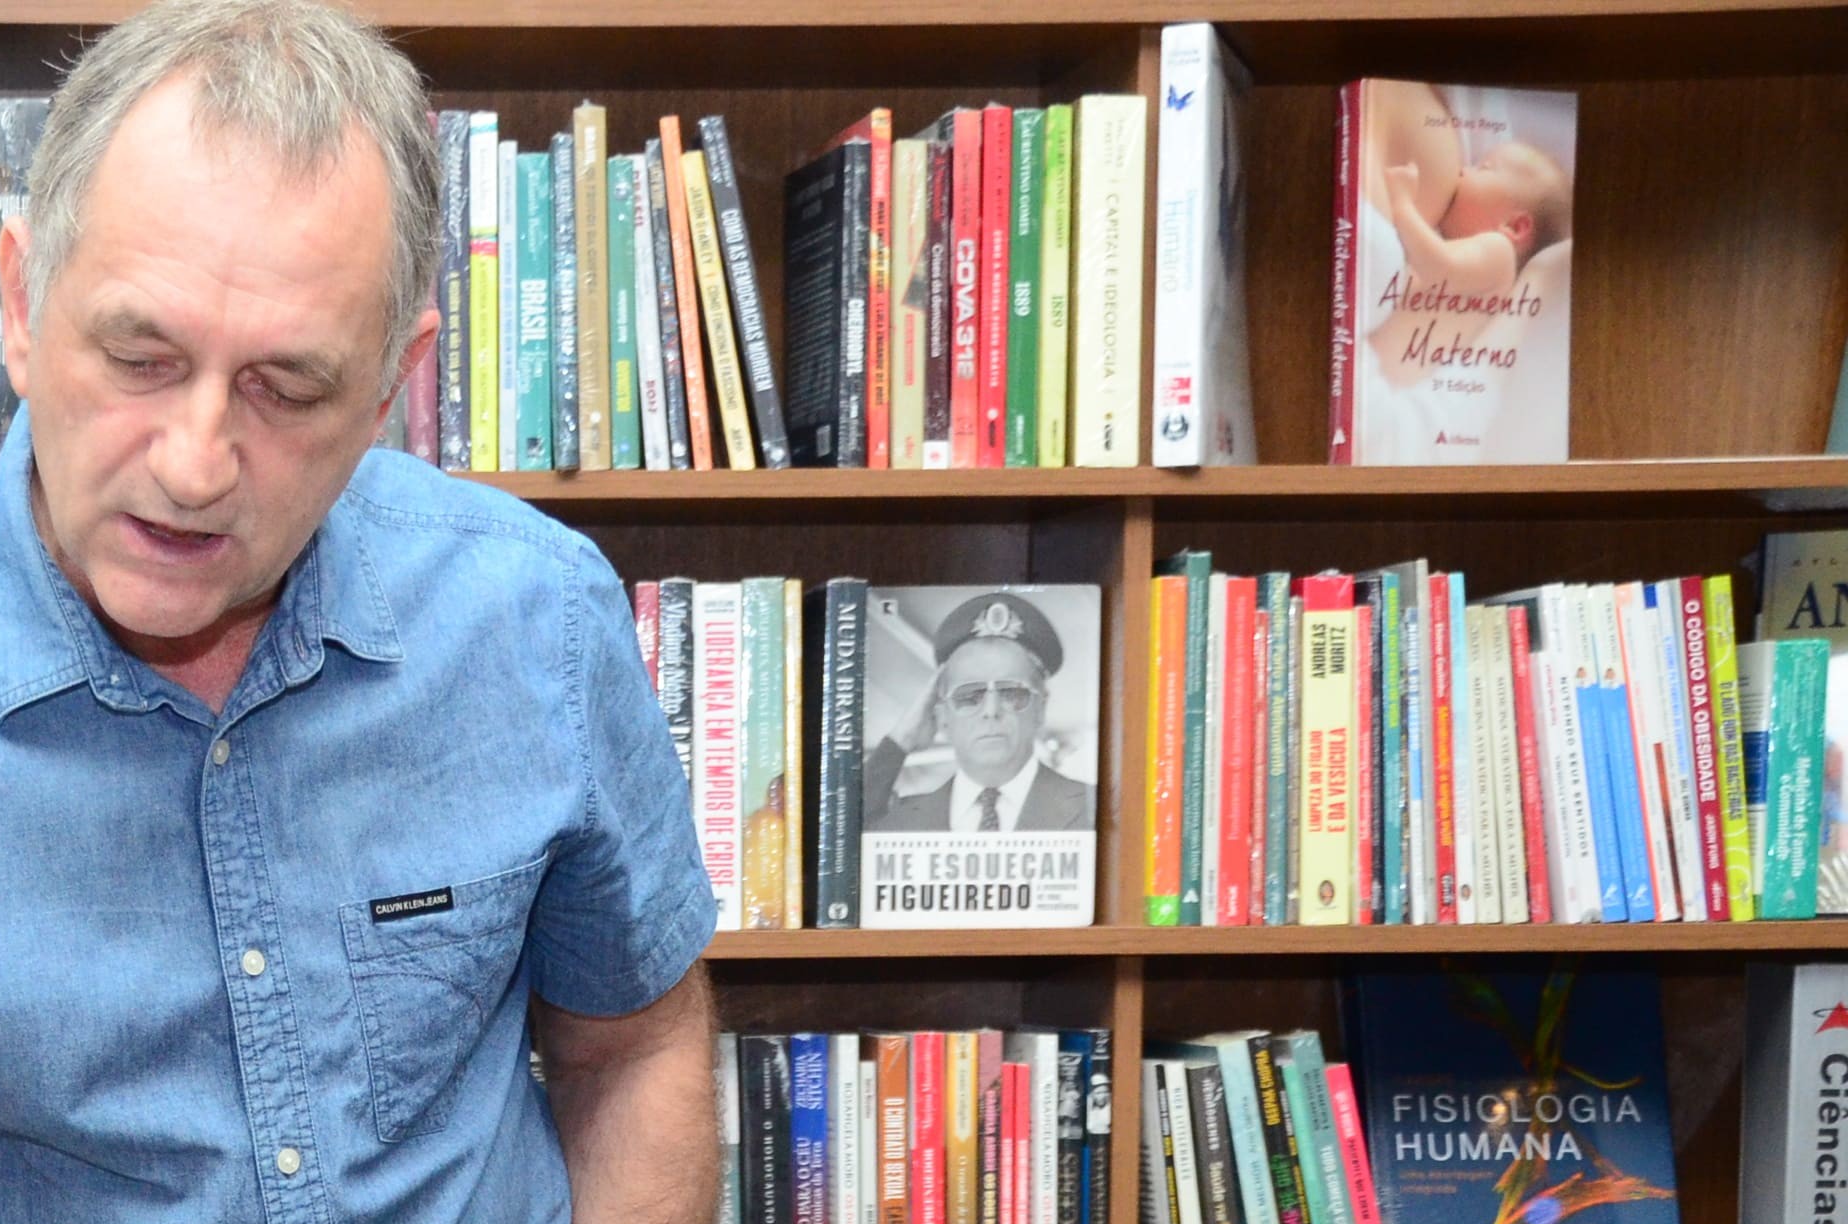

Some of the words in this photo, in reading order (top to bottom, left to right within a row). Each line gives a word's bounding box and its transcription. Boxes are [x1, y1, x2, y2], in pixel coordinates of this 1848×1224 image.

[1018, 117, 1033, 194] LAURENTINO
[721, 207, 742, 244] COMO
[1018, 196, 1032, 237] GOMES
[727, 246, 746, 261] AS
[519, 279, 547, 345] BRASIL
[729, 262, 762, 341] DEMOCRACIAS
[1015, 280, 1032, 317] 1889
[1377, 270, 1542, 318] Aleitamento
[846, 297, 865, 377] CHERNOBYL
[1400, 320, 1518, 369] Materno
[747, 343, 774, 393] MORREM
[1684, 599, 1701, 614] O
[836, 601, 858, 674] MUDA
[1311, 623, 1327, 679] ANDREAS
[1330, 626, 1346, 674] MORITZ
[1686, 616, 1708, 681] CÓDIGO
[701, 619, 735, 712] LIDERANÇA
[833, 676, 856, 758] BRASIL
[1691, 684, 1711, 708] DA
[705, 717, 735, 741] EM
[705, 745, 735, 812] TEMPOS
[1327, 727, 1347, 794] VESÍCULA
[1692, 710, 1717, 803] OBESIDADE
[1327, 798, 1345, 817] DA
[1791, 756, 1812, 813] Medicina
[705, 816, 735, 837] DE
[1328, 822, 1345, 833] E
[1791, 813, 1808, 829] de
[705, 840, 735, 888] CRISE
[874, 852, 913, 881] ME
[929, 851, 1079, 885] ESQUEÇAM
[1789, 831, 1809, 878] Família
[375, 902, 403, 915] CALVIN
[403, 899, 424, 911] KLEIN
[424, 894, 449, 908] JEANS
[874, 883, 1032, 912] FIGUEIREDO
[808, 1051, 823, 1111] SITCHIN
[883, 1097, 905, 1106] O
[1392, 1093, 1642, 1124] FISIOLOGIA
[883, 1106, 905, 1160] CONTRATO
[1395, 1131, 1584, 1162] HUMANA
[884, 1162, 905, 1201] SEXUAL
